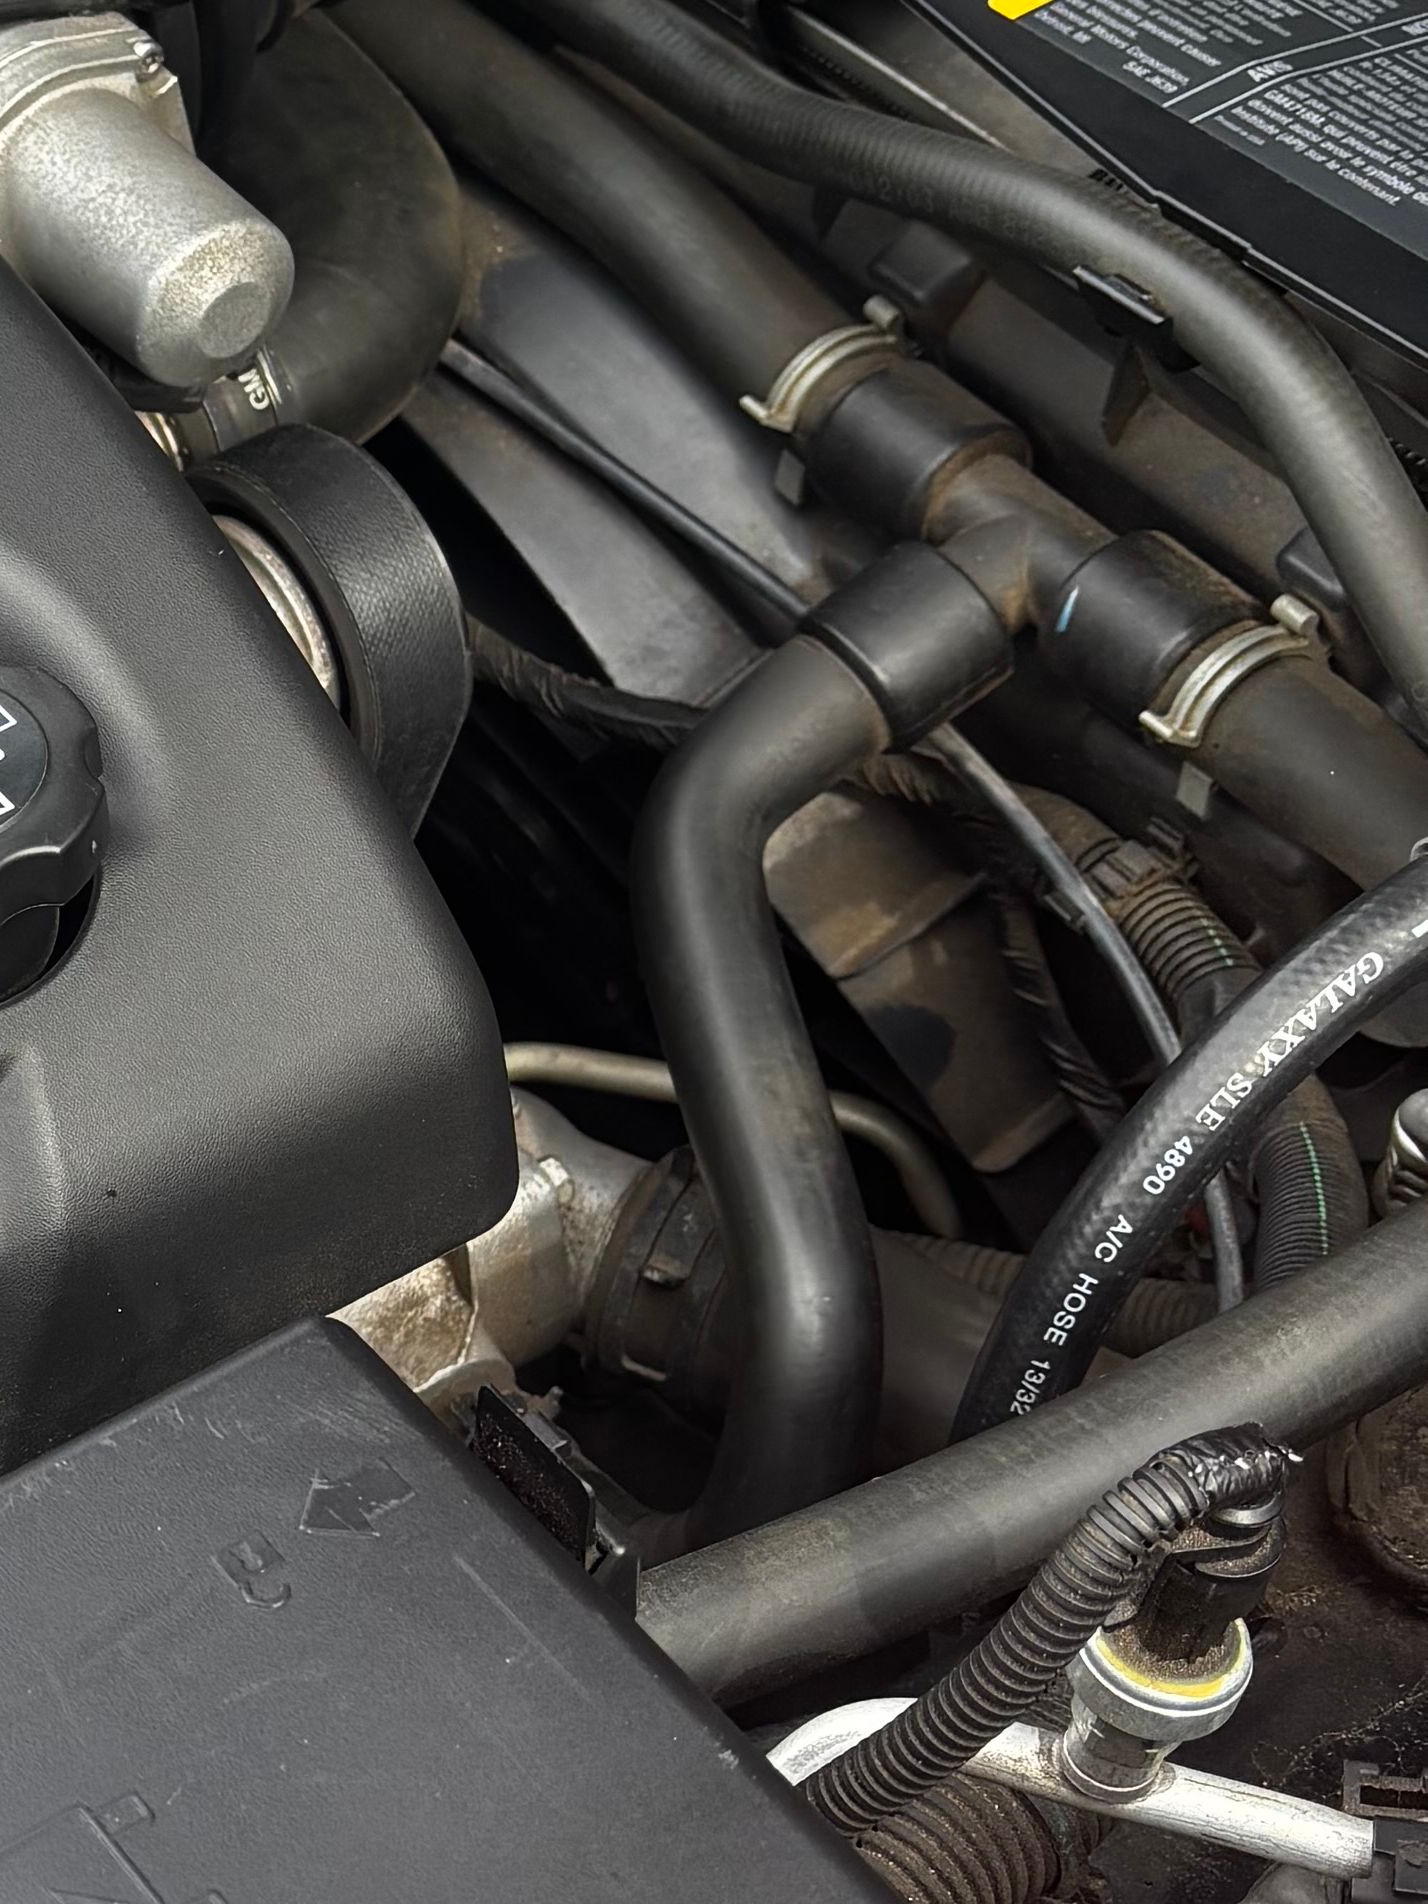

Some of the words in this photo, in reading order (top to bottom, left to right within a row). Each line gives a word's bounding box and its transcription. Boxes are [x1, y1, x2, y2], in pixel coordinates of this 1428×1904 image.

[1255, 951, 1385, 1077] GALAXY
[1195, 1072, 1253, 1132] SLE
[1142, 1135, 1194, 1196] 4890
[1094, 1214, 1134, 1264] A/C
[1043, 1272, 1099, 1347] HOSE
